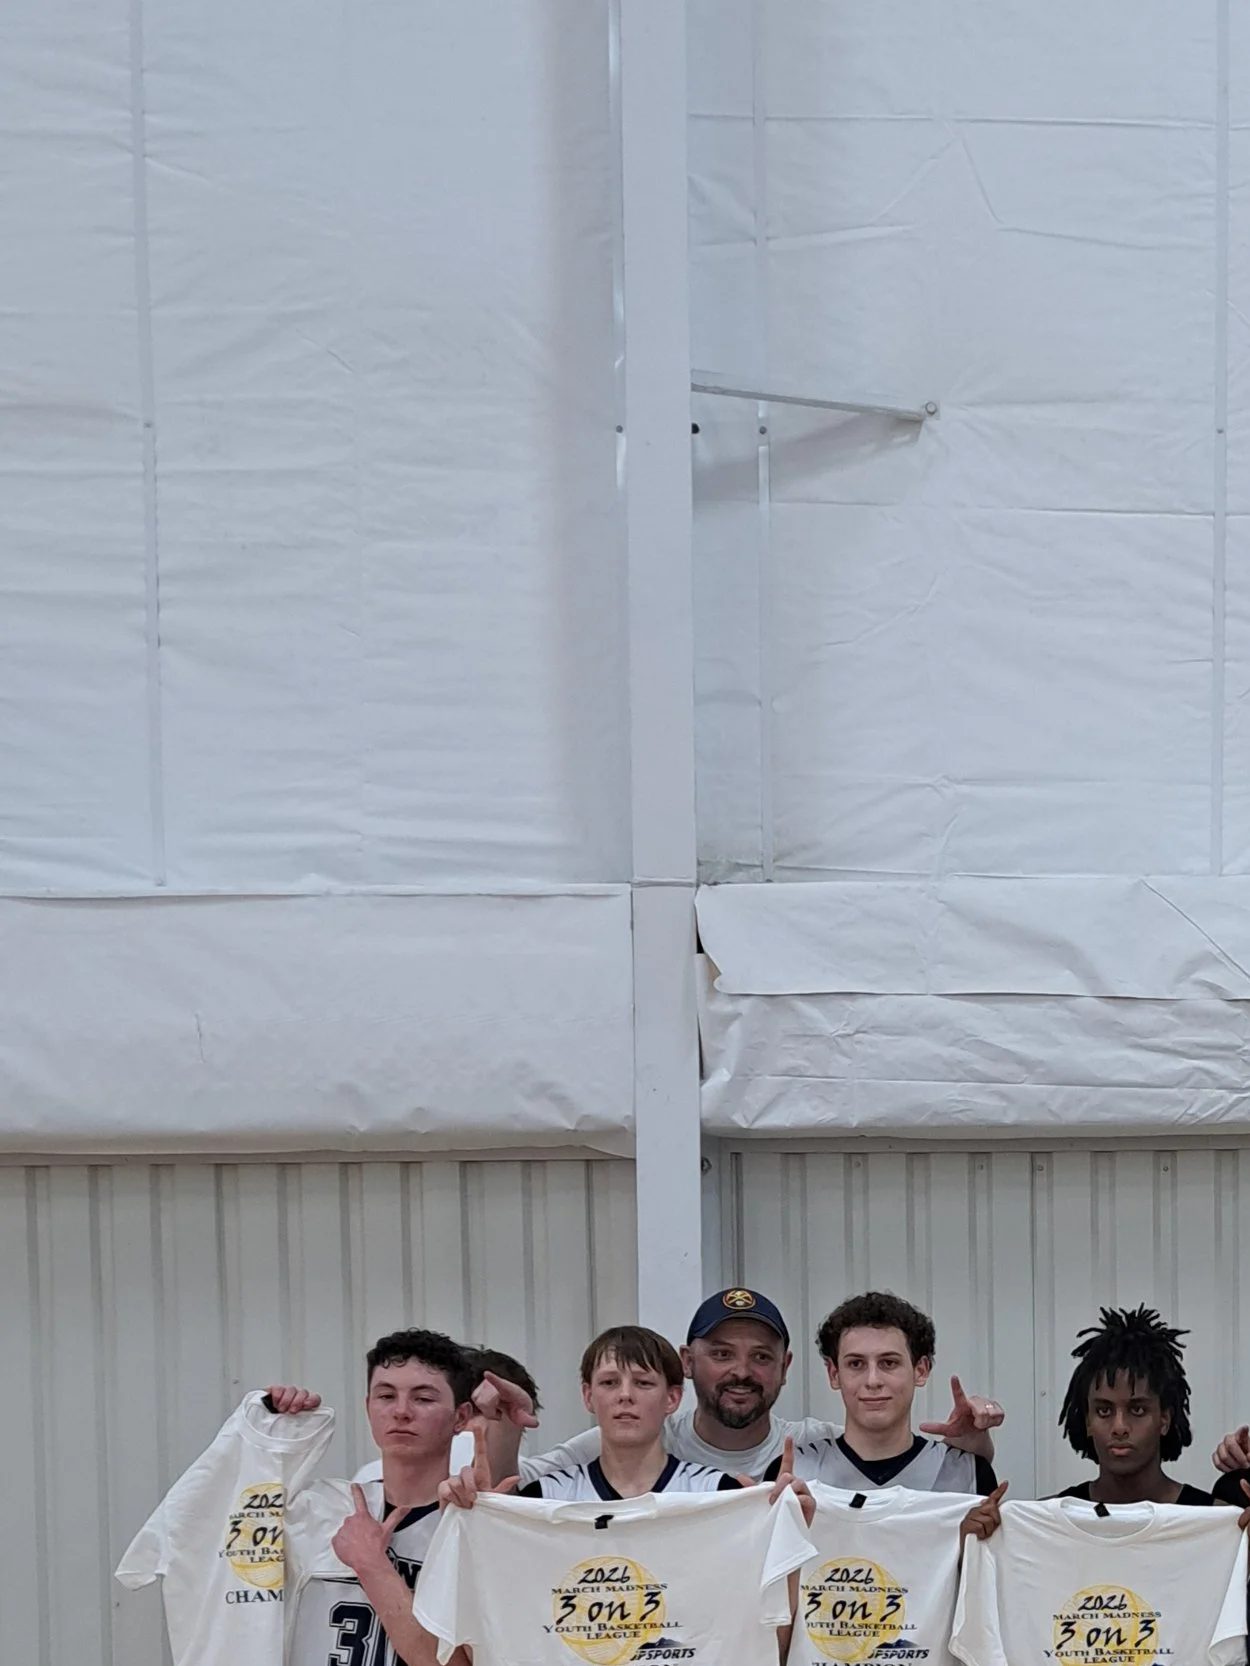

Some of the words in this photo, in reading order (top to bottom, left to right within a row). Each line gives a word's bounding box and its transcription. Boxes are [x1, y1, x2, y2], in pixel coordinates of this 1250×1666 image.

[243, 1493, 284, 1510] 202
[226, 1520, 243, 1550] 3
[578, 1566, 631, 1584] 2026
[825, 1568, 874, 1585] 2026
[552, 1586, 600, 1595] MARCH
[605, 1583, 668, 1593] MADNESS
[801, 1584, 845, 1592] MARCH
[850, 1585, 908, 1593] MADNESS
[225, 1589, 284, 1604] CHAM
[1078, 1594, 1127, 1611] 2026
[556, 1595, 577, 1625] 3
[588, 1601, 631, 1622] on
[639, 1591, 662, 1622] 3
[805, 1592, 823, 1620] 3
[832, 1600, 872, 1620] on
[880, 1594, 902, 1622] 3
[1053, 1613, 1099, 1621] MARCH
[1103, 1611, 1162, 1619] MADNESS
[598, 1621, 683, 1632] BASKETBALL
[840, 1620, 917, 1631] BASKETBALL
[587, 1631, 641, 1640] LEAGUE
[829, 1629, 880, 1637] LEAGUE
[1056, 1621, 1077, 1650] 3
[1086, 1627, 1127, 1647] on
[1134, 1619, 1156, 1648] 3
[1095, 1647, 1174, 1656] BASKETBALL
[1084, 1655, 1136, 1664] LEAGUE
